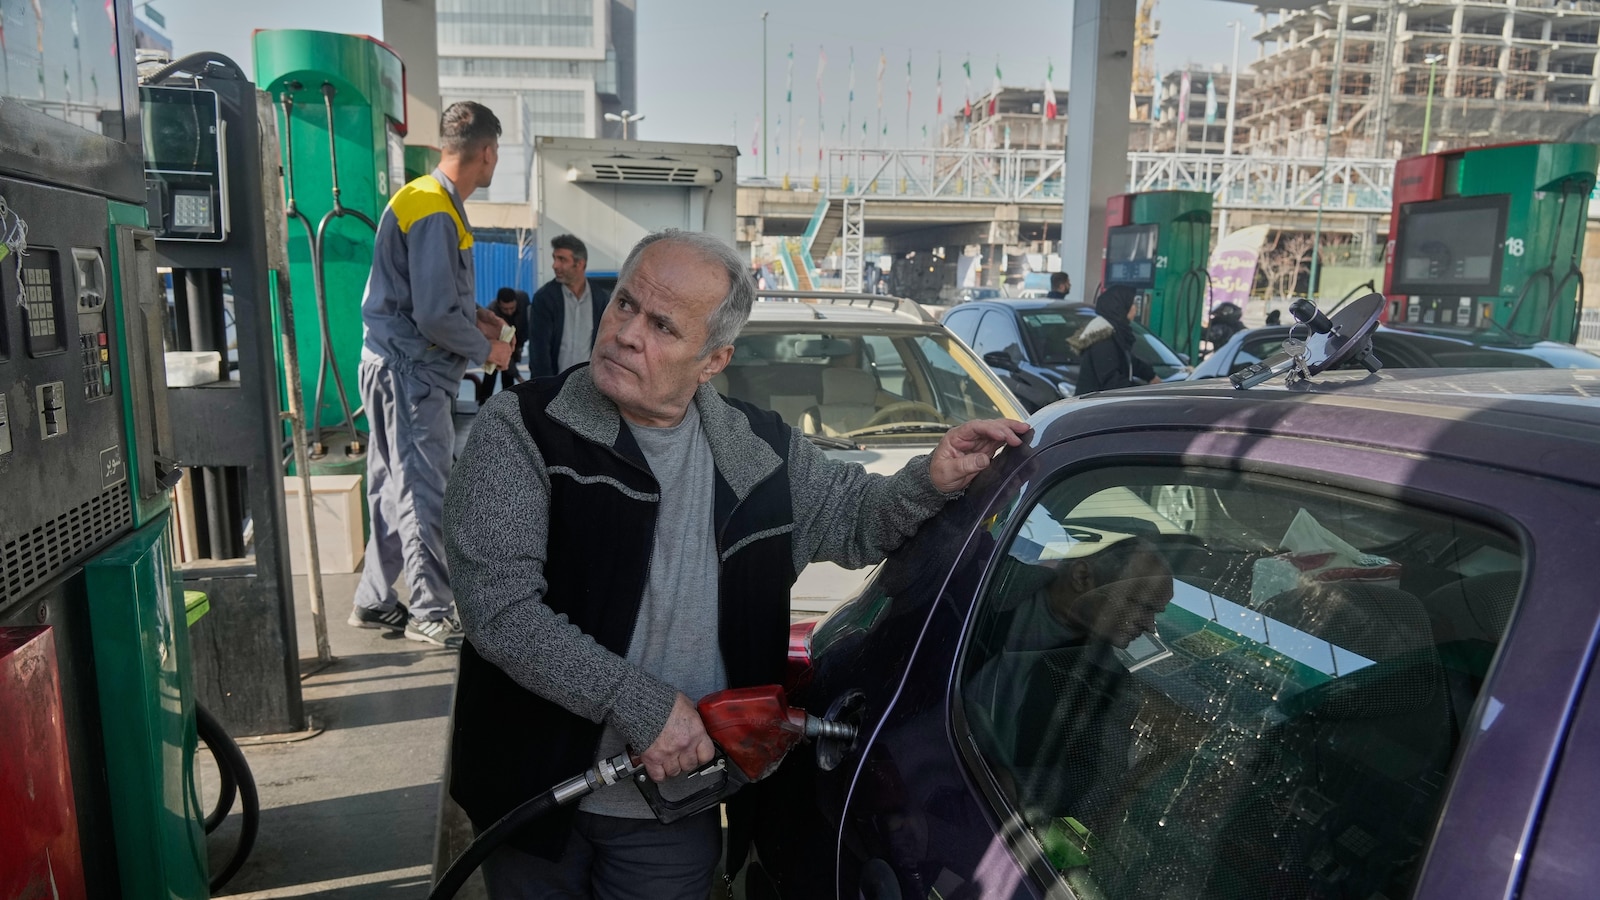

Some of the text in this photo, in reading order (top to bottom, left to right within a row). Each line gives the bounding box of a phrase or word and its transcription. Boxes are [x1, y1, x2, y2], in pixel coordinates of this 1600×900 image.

[379, 171, 387, 195] 8
[1505, 237, 1525, 257] 18
[1156, 256, 1168, 269] 21
